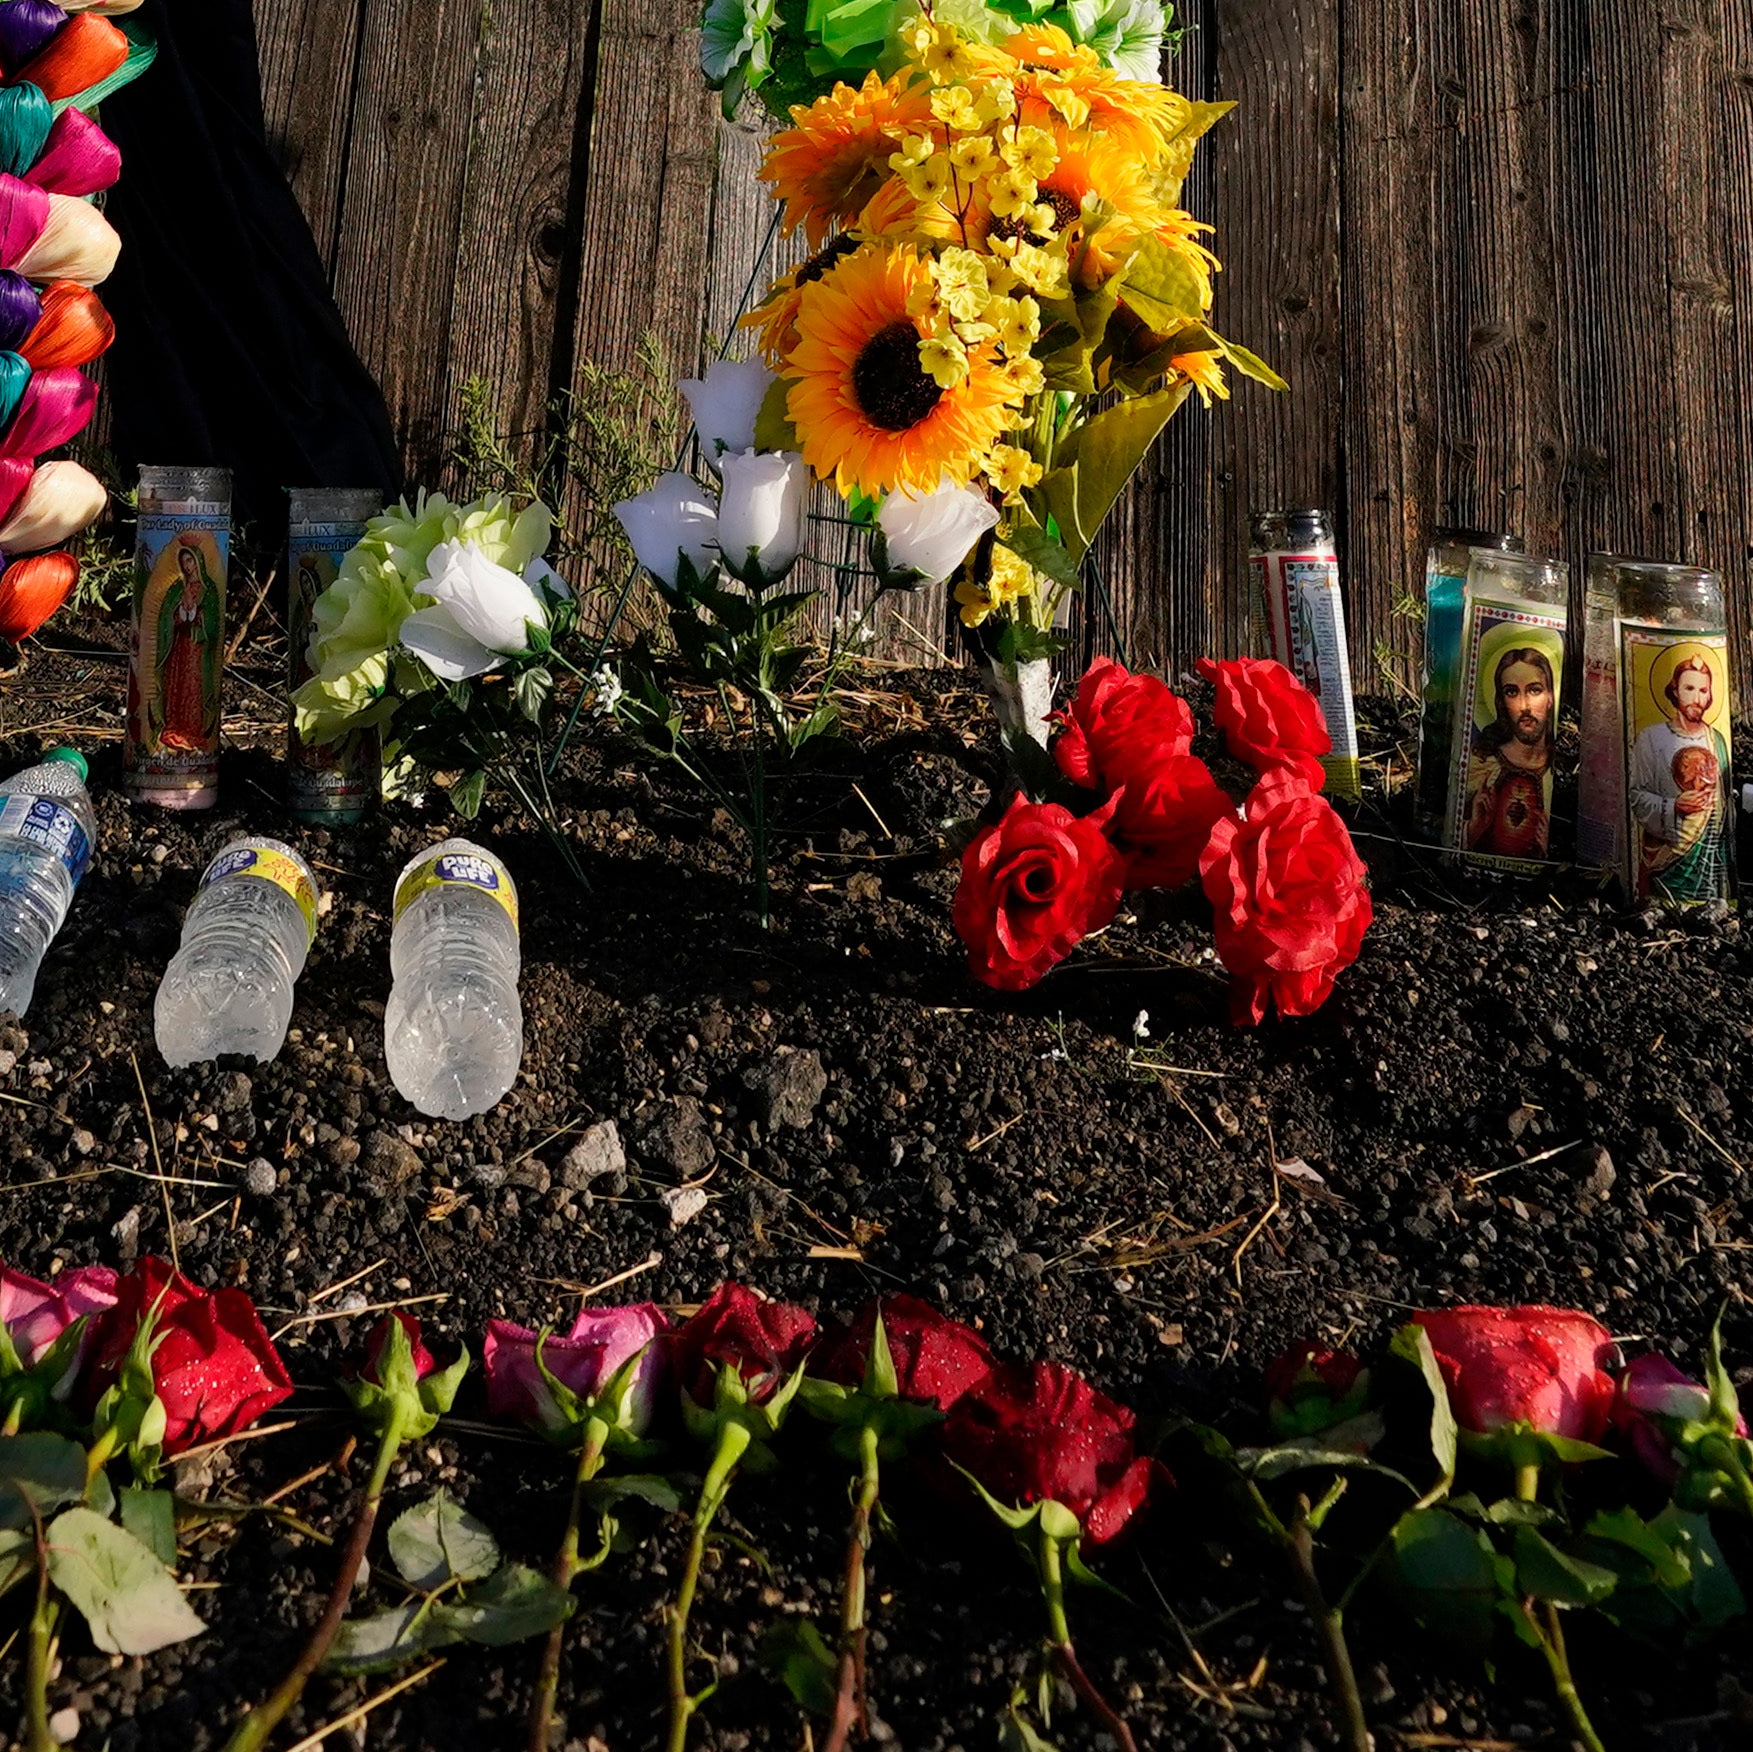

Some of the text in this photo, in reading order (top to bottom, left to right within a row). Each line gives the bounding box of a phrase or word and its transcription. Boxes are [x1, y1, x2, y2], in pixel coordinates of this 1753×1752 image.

[157, 518, 183, 532] Lady
[441, 855, 494, 876] PURE
[452, 868, 491, 884] LIFE
